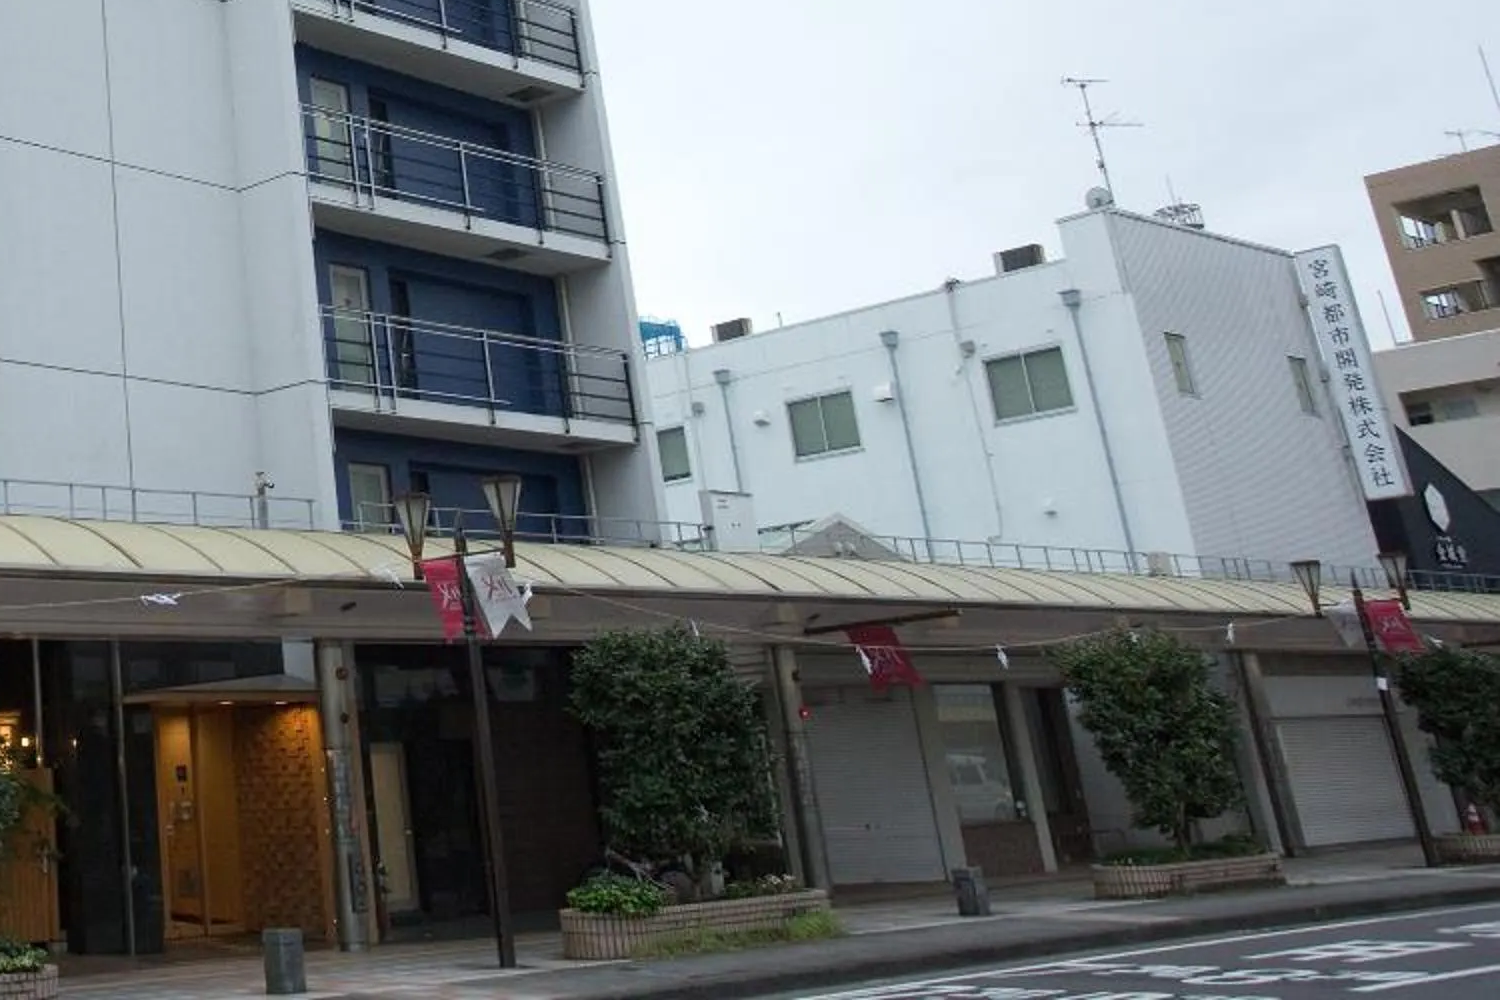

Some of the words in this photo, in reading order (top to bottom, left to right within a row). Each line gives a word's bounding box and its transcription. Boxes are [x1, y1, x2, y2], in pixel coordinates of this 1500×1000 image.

[1308, 258, 1396, 489] 宮崎都市開発株式会社
